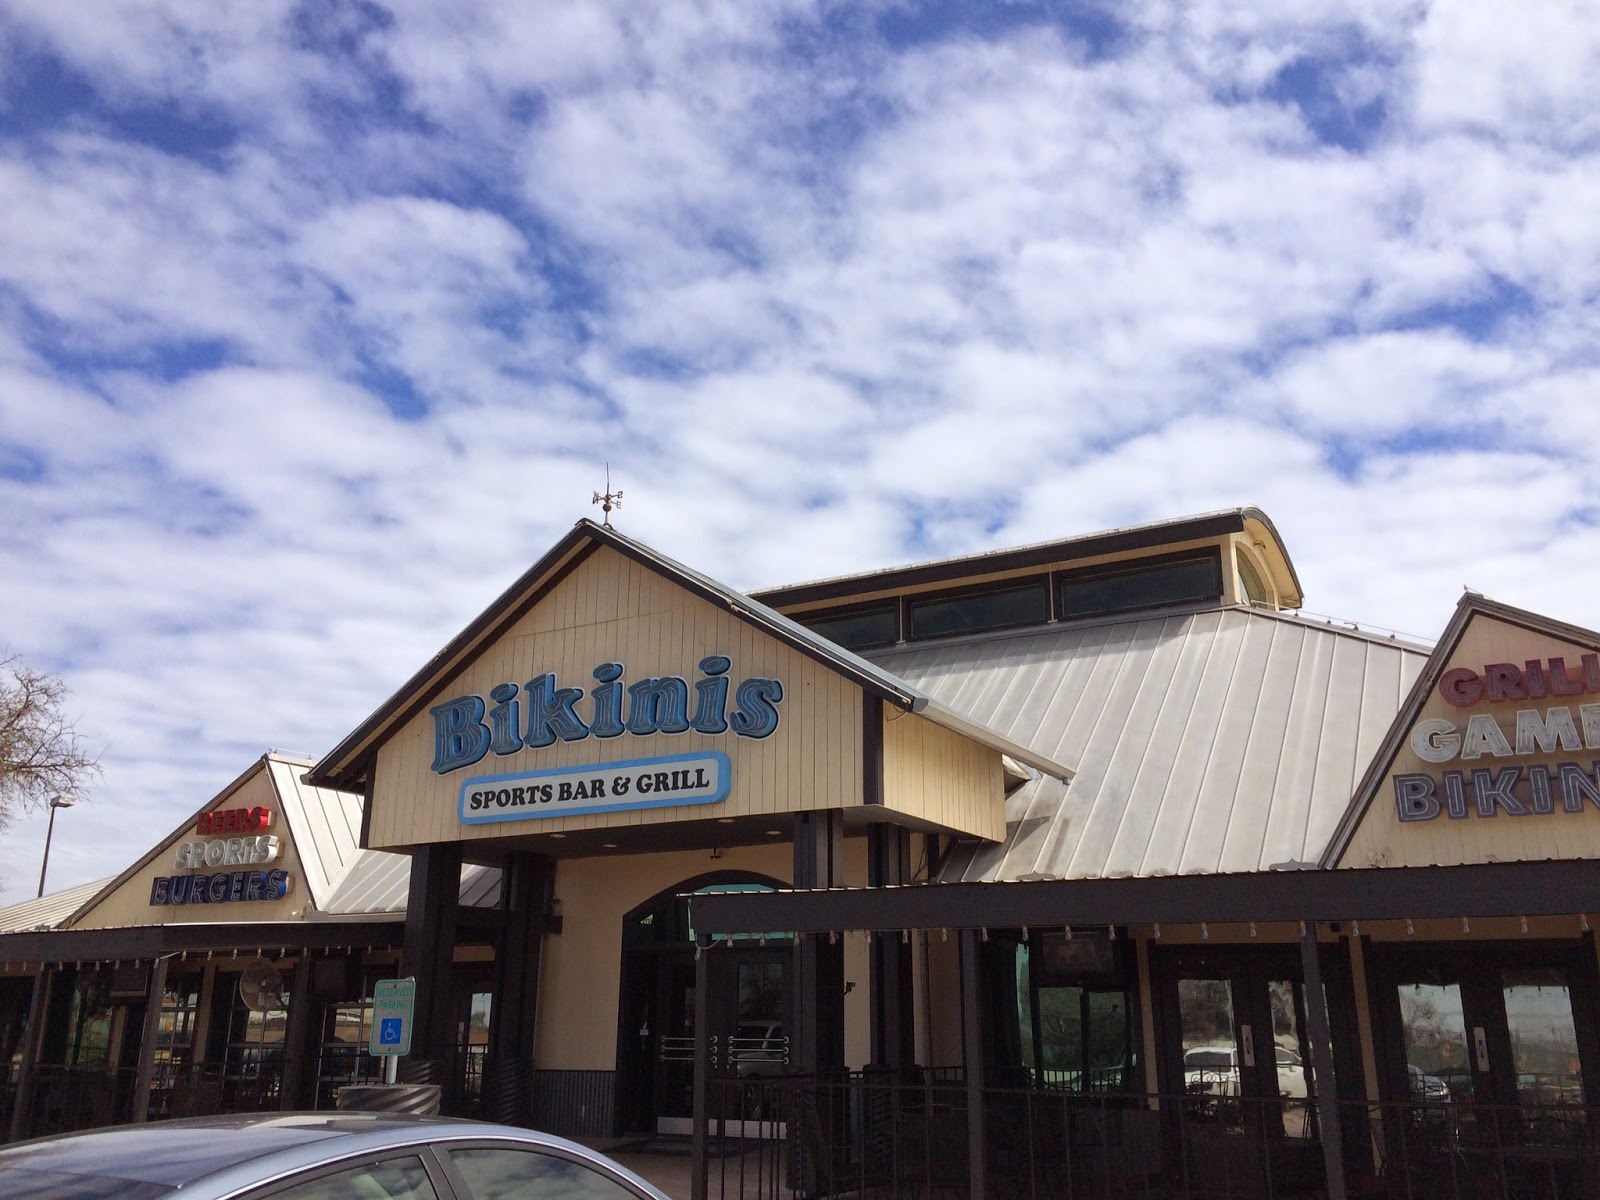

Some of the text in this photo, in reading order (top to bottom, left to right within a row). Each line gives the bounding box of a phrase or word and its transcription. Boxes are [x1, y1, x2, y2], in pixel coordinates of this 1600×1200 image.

[428, 654, 784, 775] Bikinis
[470, 768, 710, 810] SPORTS BAR & GRILL
[196, 807, 270, 835] BEERS
[174, 835, 278, 870] SPORTS
[149, 868, 288, 906] BURGERS
[377, 987, 413, 997] RESERVED
[379, 999, 407, 1009] PARKING
